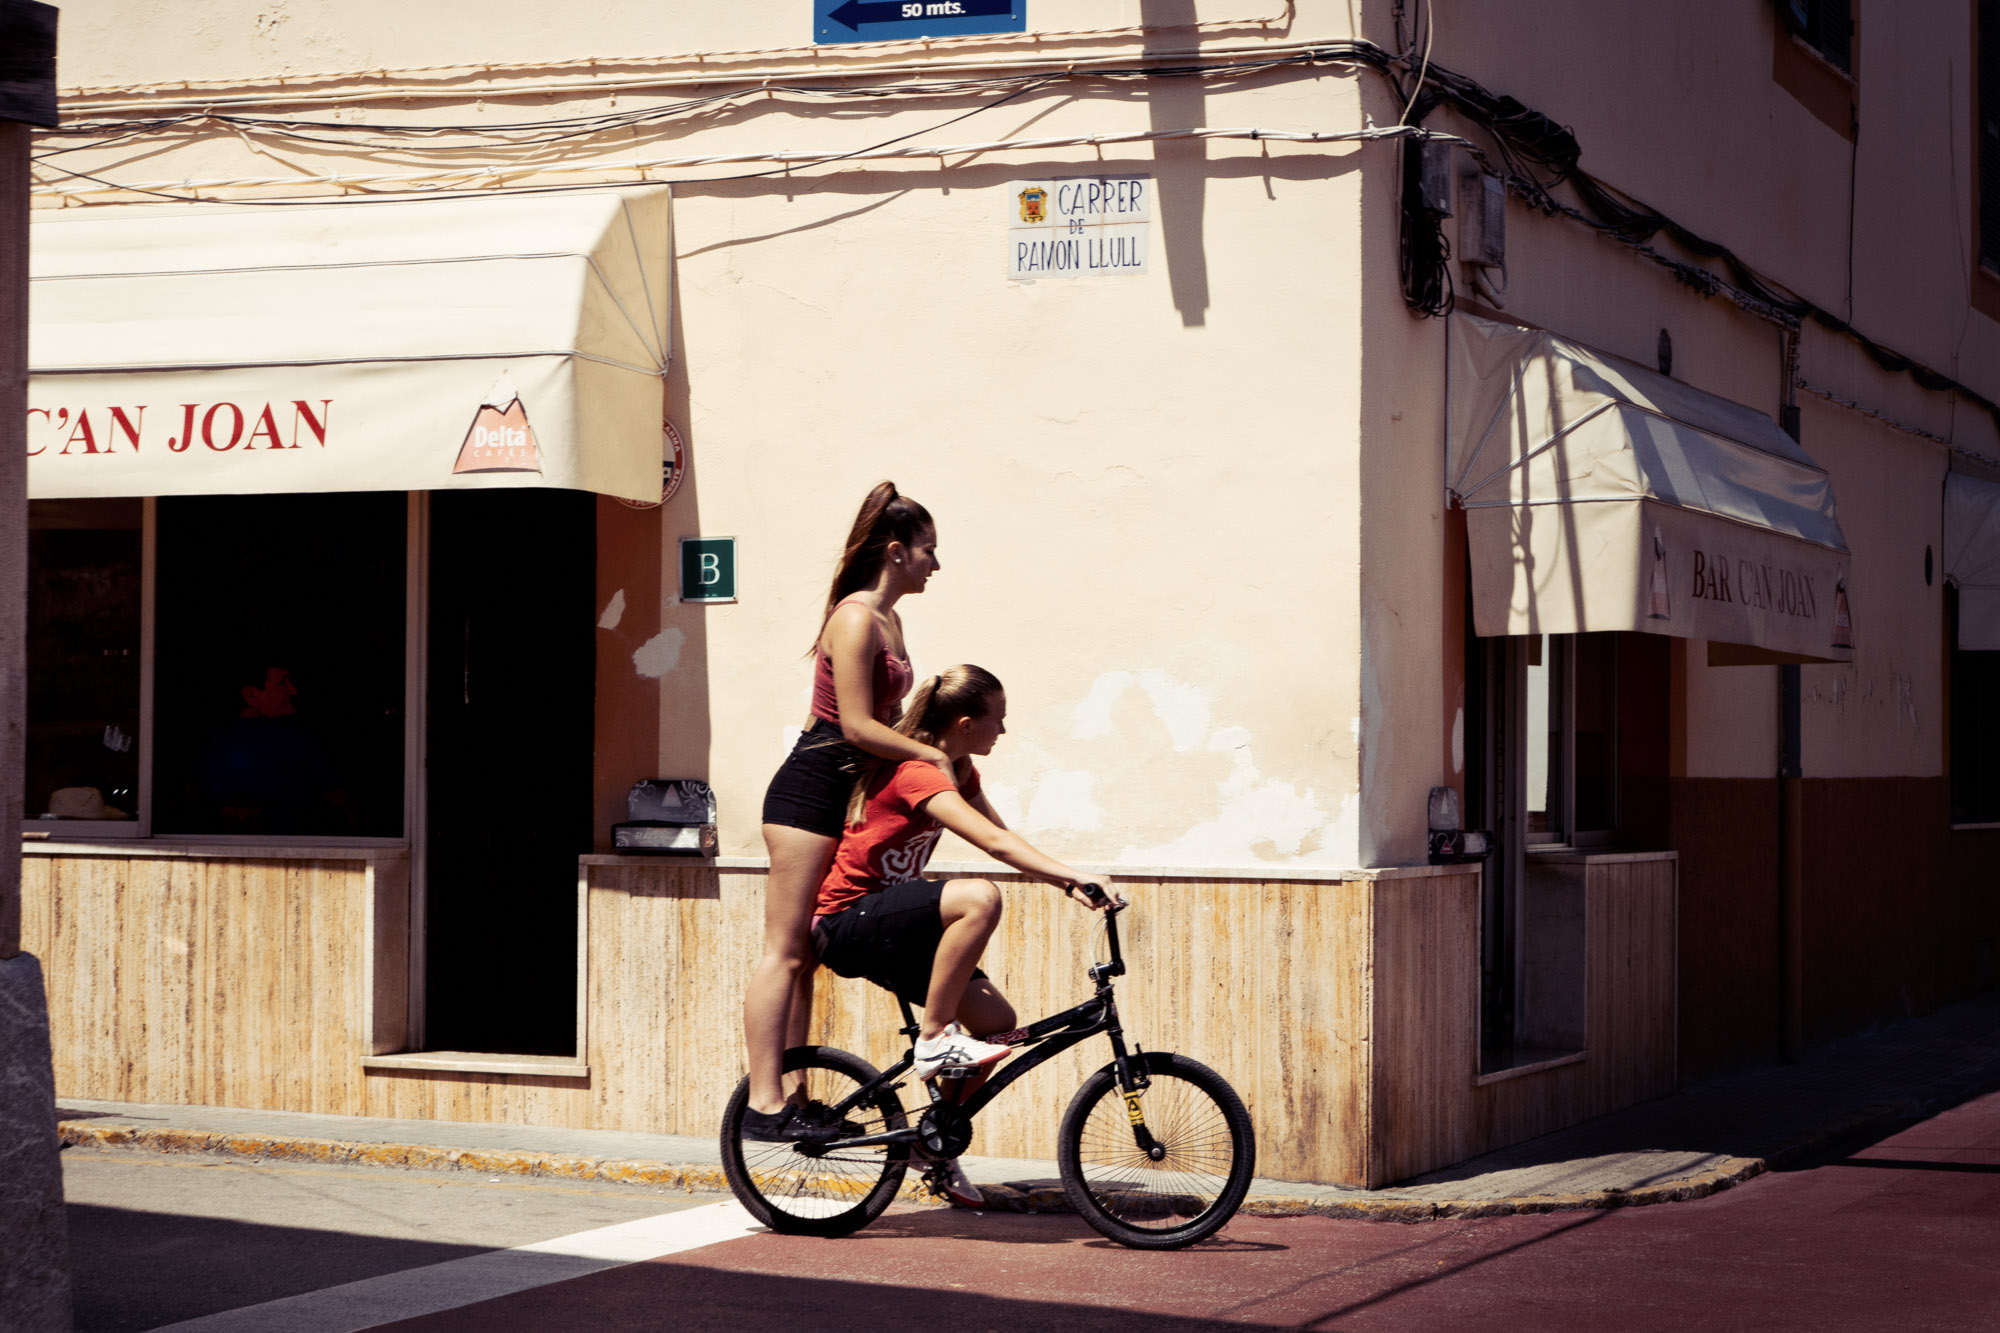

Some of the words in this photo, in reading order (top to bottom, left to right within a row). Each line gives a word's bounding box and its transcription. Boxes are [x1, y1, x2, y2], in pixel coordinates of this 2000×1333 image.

[901, 3, 923, 18] 50
[926, 1, 966, 16] mts.
[1058, 180, 1143, 215] CARRER
[1069, 218, 1085, 235] DE
[1017, 239, 1080, 272] RAMON
[1089, 236, 1142, 269] LLULL
[168, 399, 334, 454] JOAN
[474, 425, 525, 447] Delta
[696, 552, 721, 585] B
[1691, 549, 1733, 603] BAR
[1778, 567, 1817, 621] JOAN
